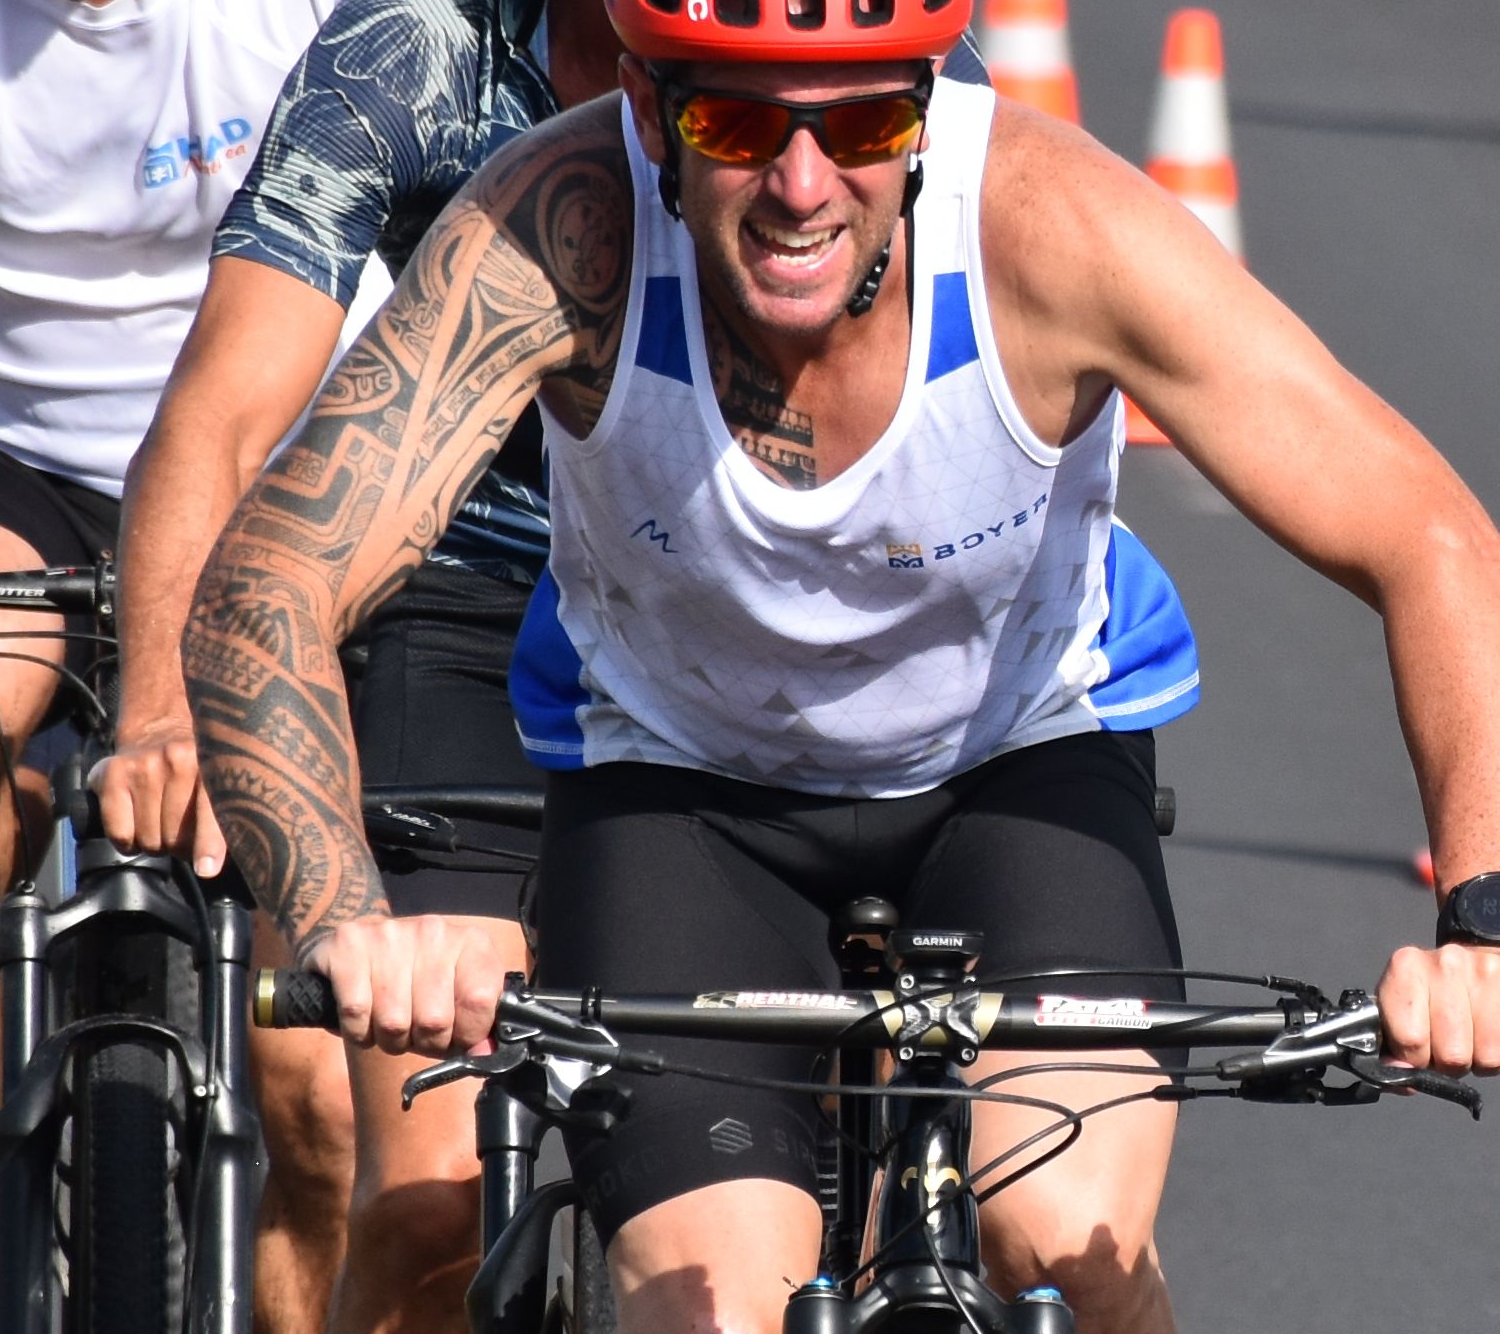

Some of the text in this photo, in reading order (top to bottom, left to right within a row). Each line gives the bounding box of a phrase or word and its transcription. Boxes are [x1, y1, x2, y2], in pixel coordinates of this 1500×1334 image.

[933, 493, 1048, 560] BOYER
[912, 936, 963, 947] GARMIN
[735, 991, 850, 1010] RENTHAL
